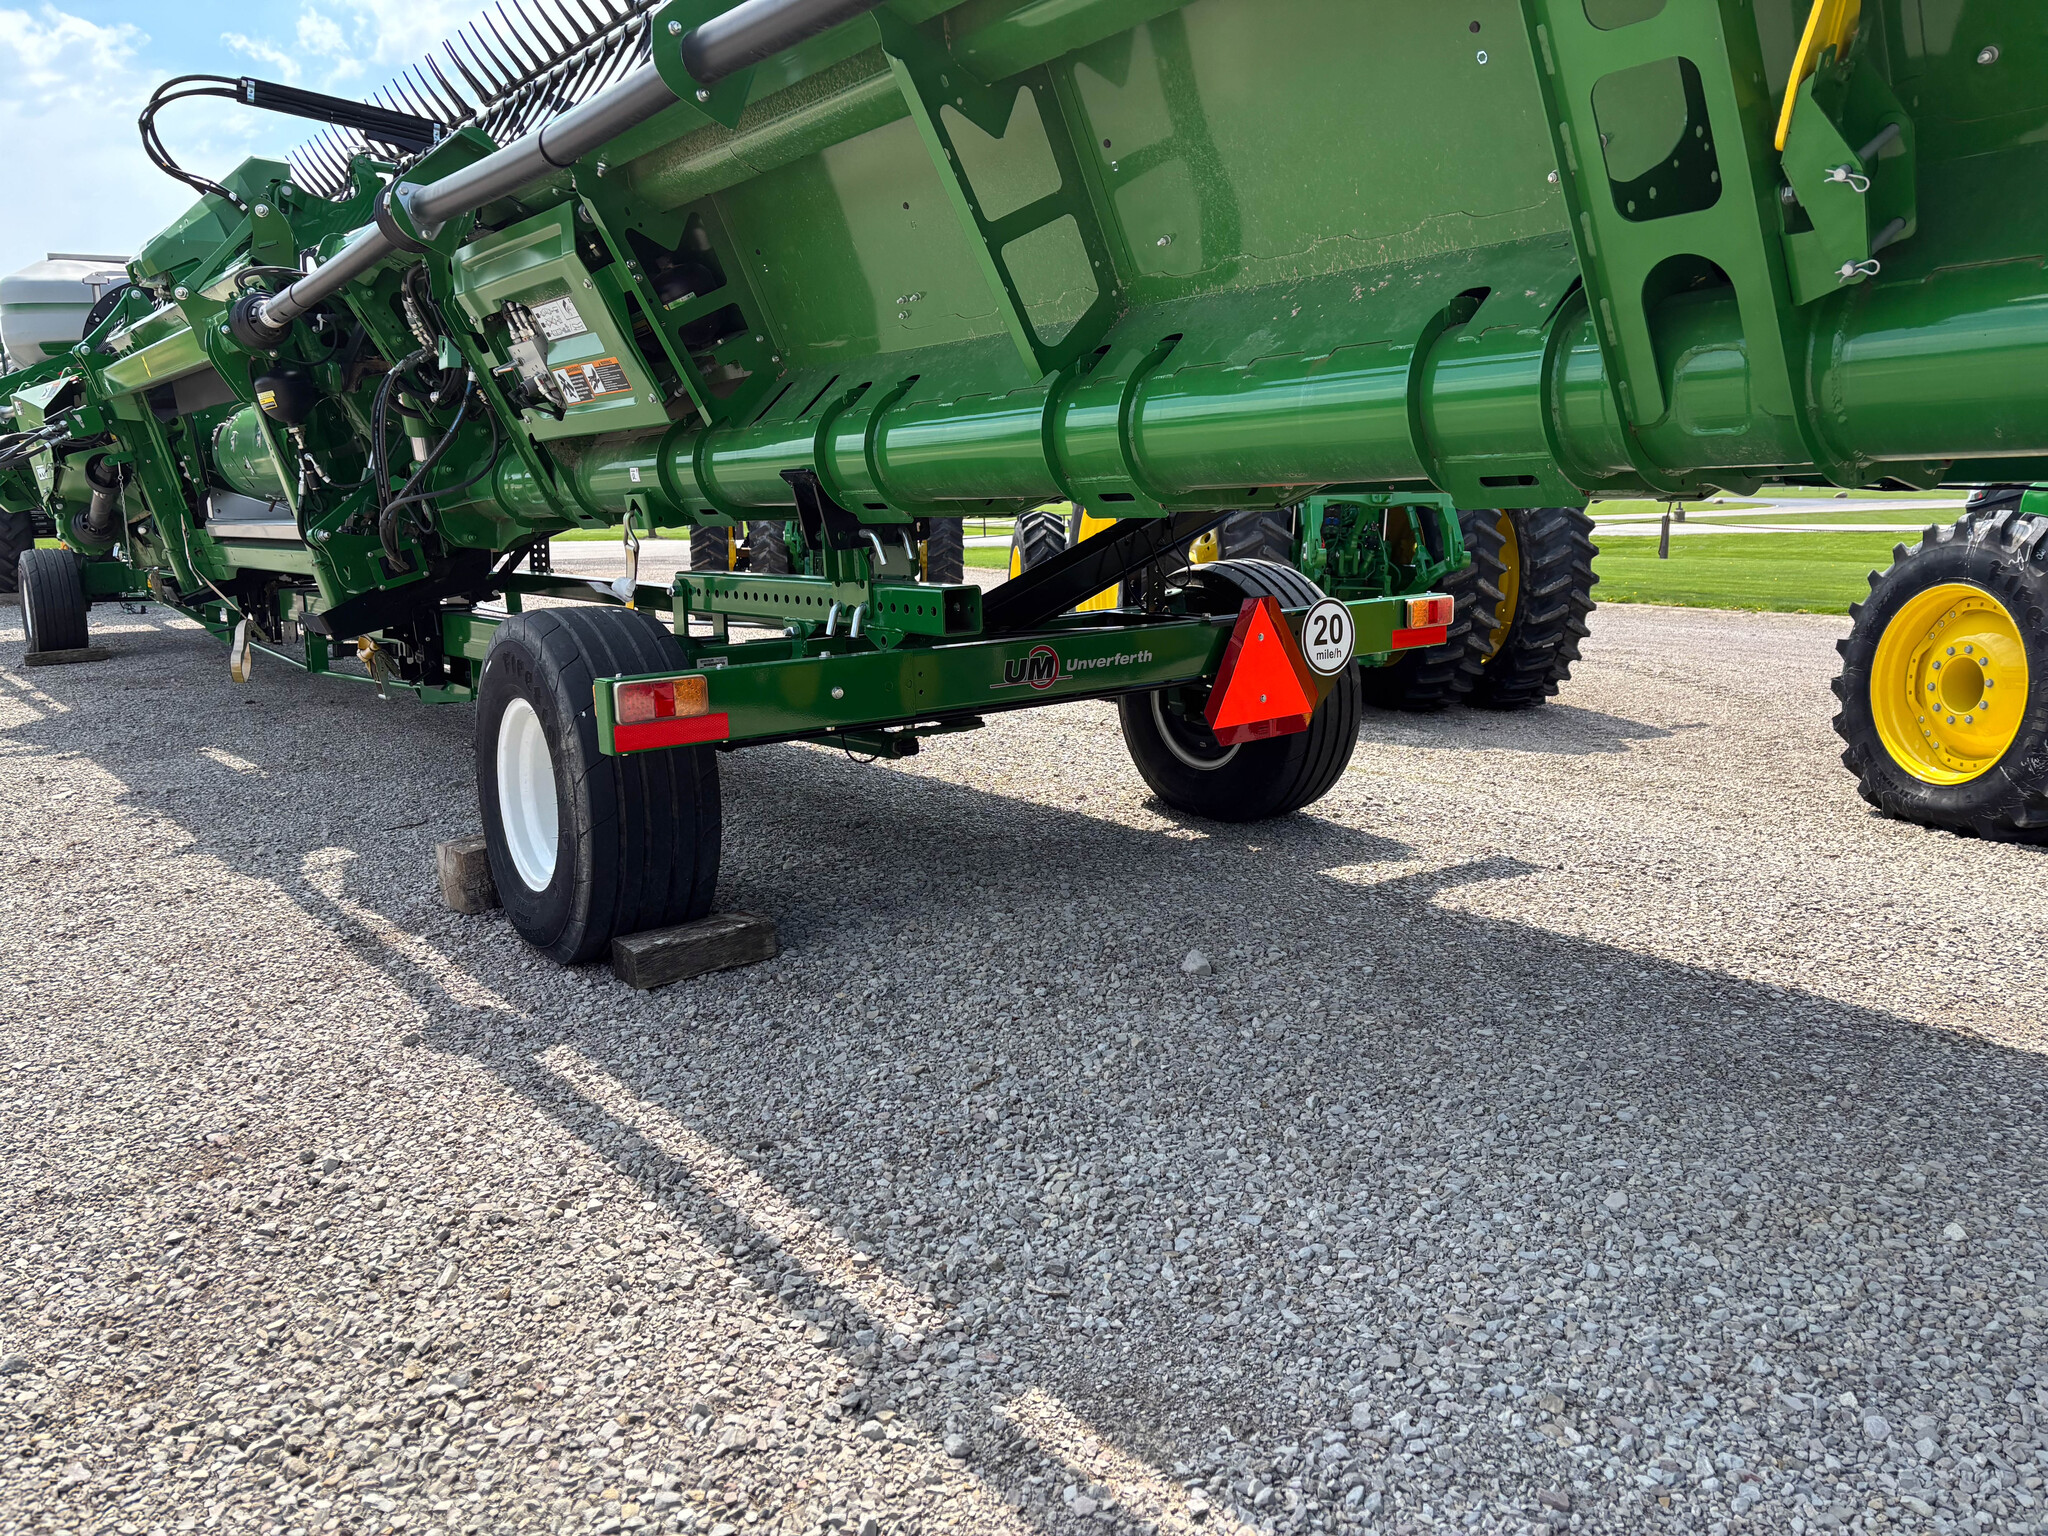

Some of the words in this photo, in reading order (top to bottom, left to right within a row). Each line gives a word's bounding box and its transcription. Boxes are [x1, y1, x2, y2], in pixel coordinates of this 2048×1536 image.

[1314, 614, 1343, 646] 20
[1004, 653, 1056, 683] UM
[1066, 650, 1152, 671] Unverferth
[1316, 648, 1342, 660] mile/h
